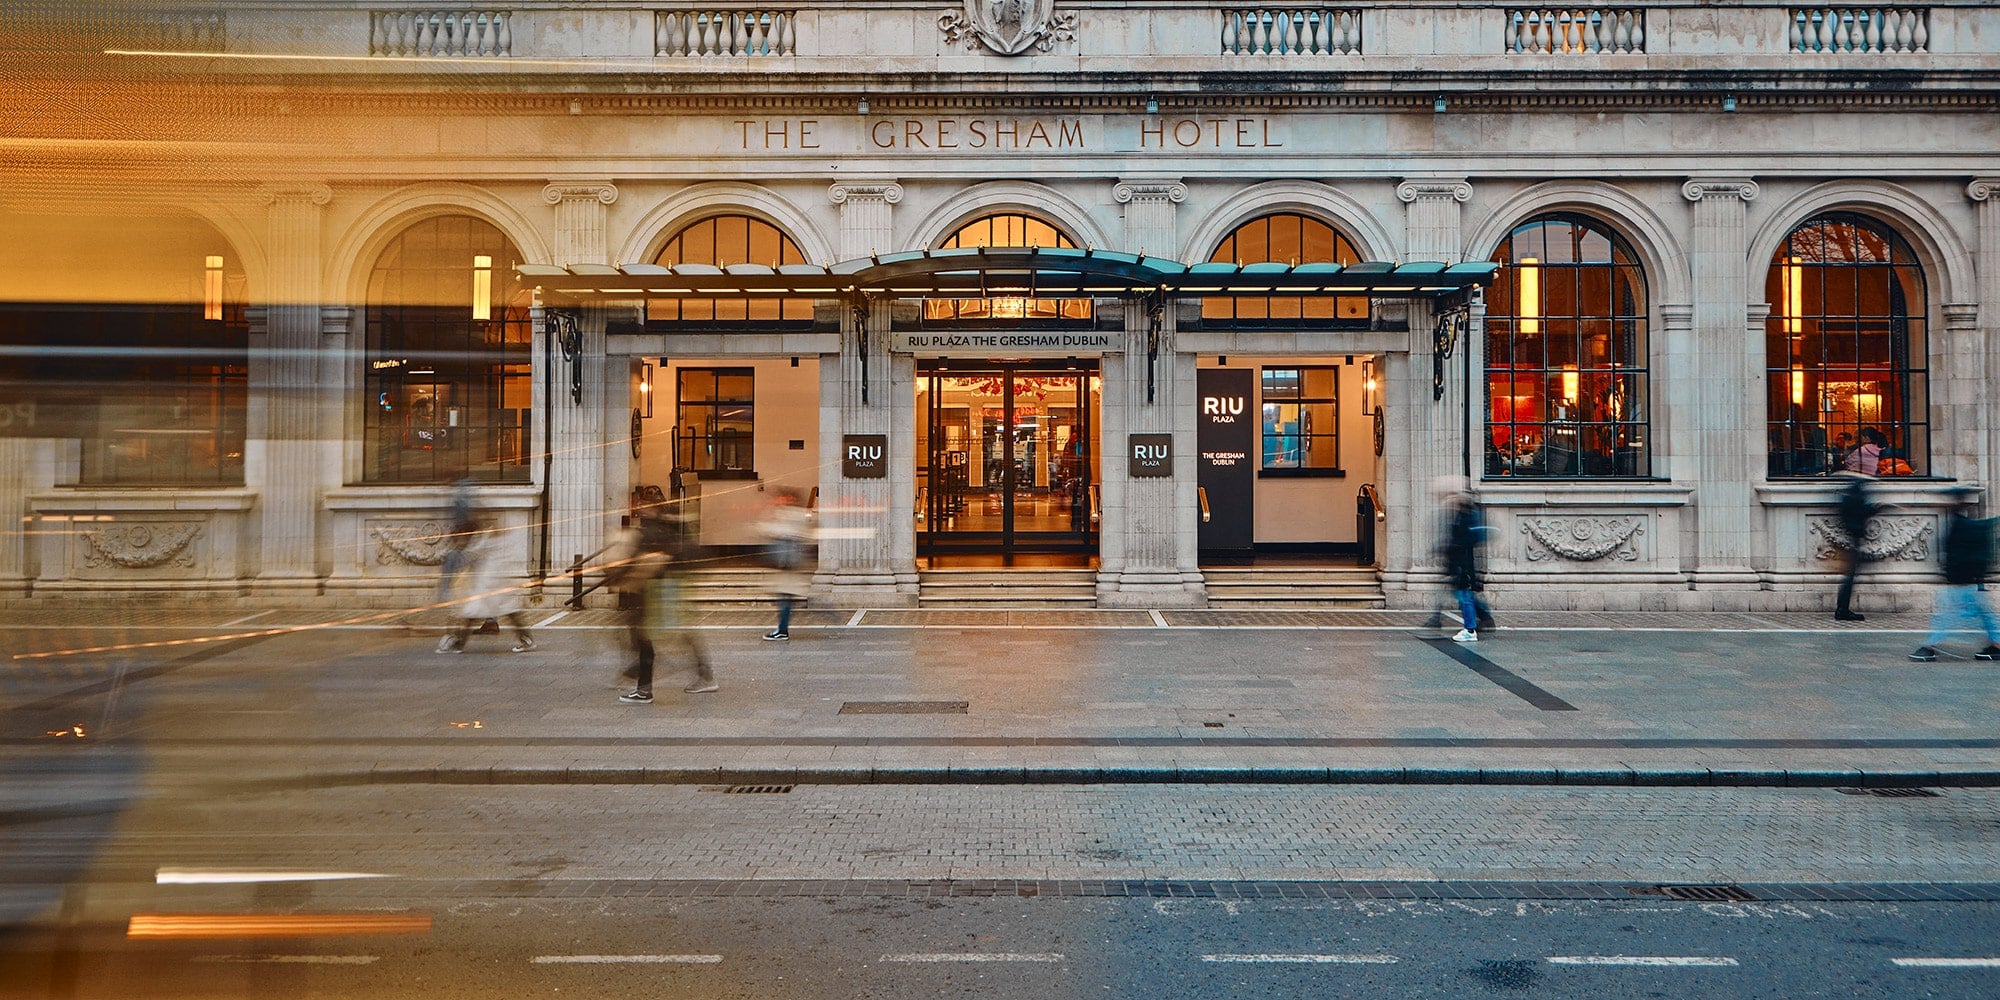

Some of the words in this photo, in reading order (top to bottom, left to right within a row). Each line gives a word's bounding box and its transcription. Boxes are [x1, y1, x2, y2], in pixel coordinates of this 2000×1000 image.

[734, 120, 820, 148] THE
[871, 119, 1085, 149] GRESHAM
[1141, 119, 1283, 148] HOTEL
[908, 336, 929, 346] RIU
[932, 335, 970, 346] PLAZA
[972, 336, 997, 346] THE
[1000, 335, 1059, 346] GRESHAM
[1063, 335, 1109, 345] DUBLIN
[1204, 397, 1244, 415] RIU
[848, 446, 882, 460] RIU
[1134, 445, 1168, 459] RIU
